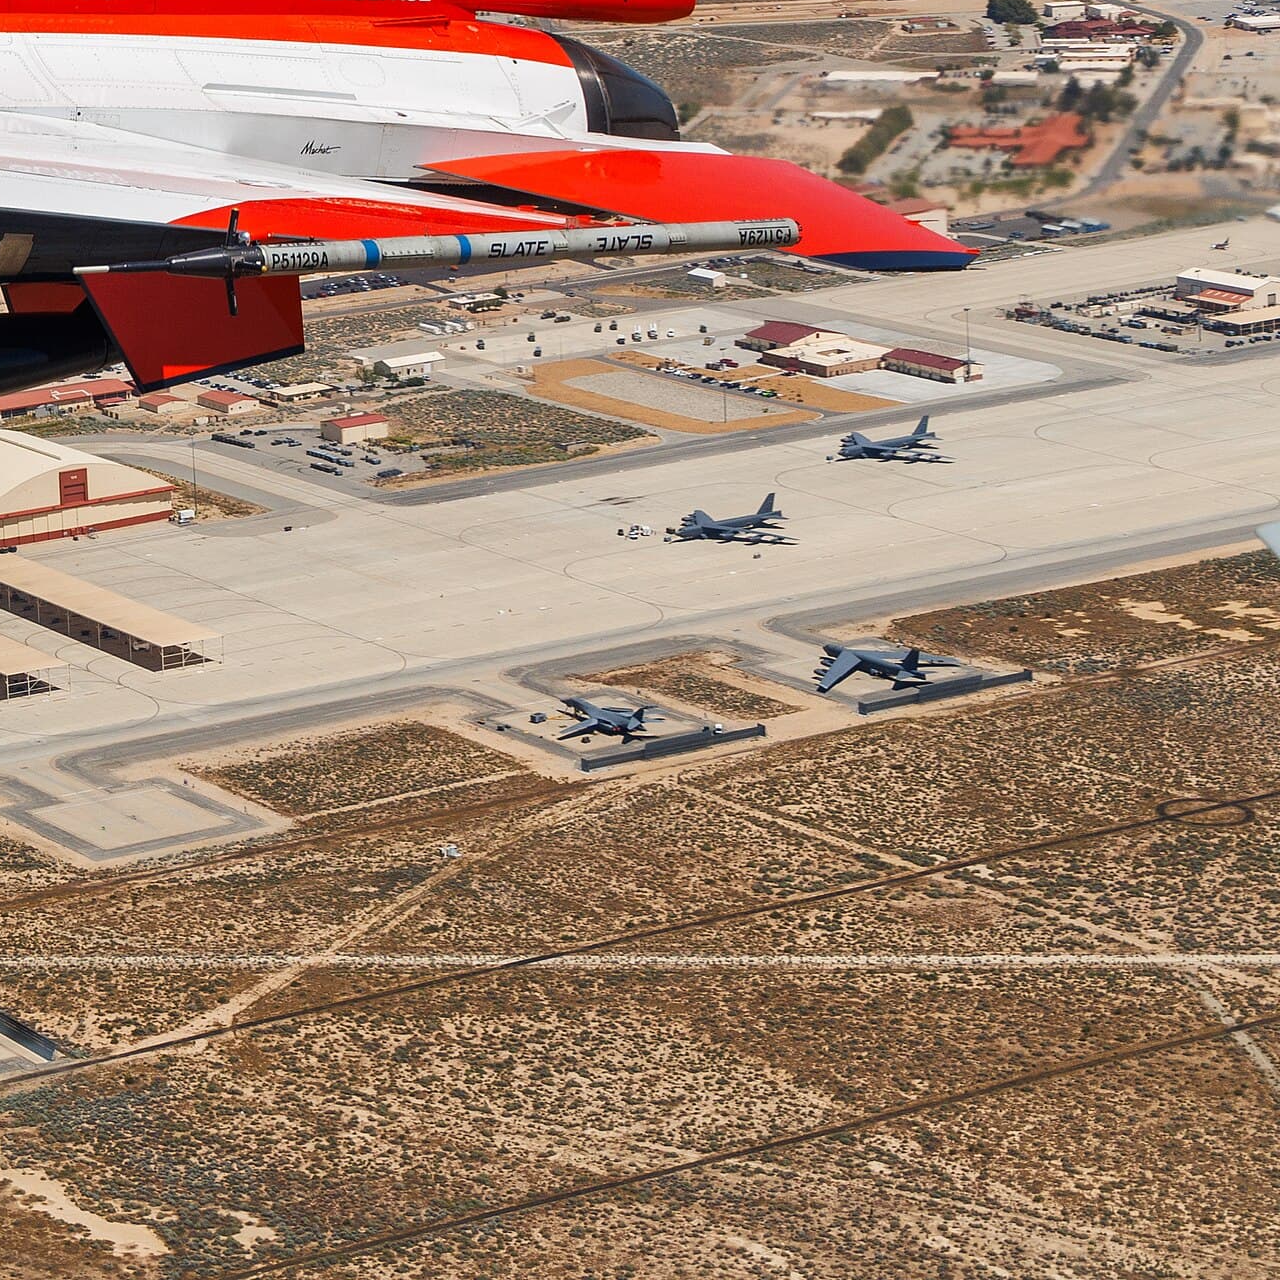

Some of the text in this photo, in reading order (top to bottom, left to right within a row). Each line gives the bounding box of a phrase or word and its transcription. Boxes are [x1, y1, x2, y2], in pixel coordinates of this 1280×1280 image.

[489, 240, 549, 259] SLATE
[594, 234, 654, 253] SLATE
[271, 251, 329, 270] P51129A
